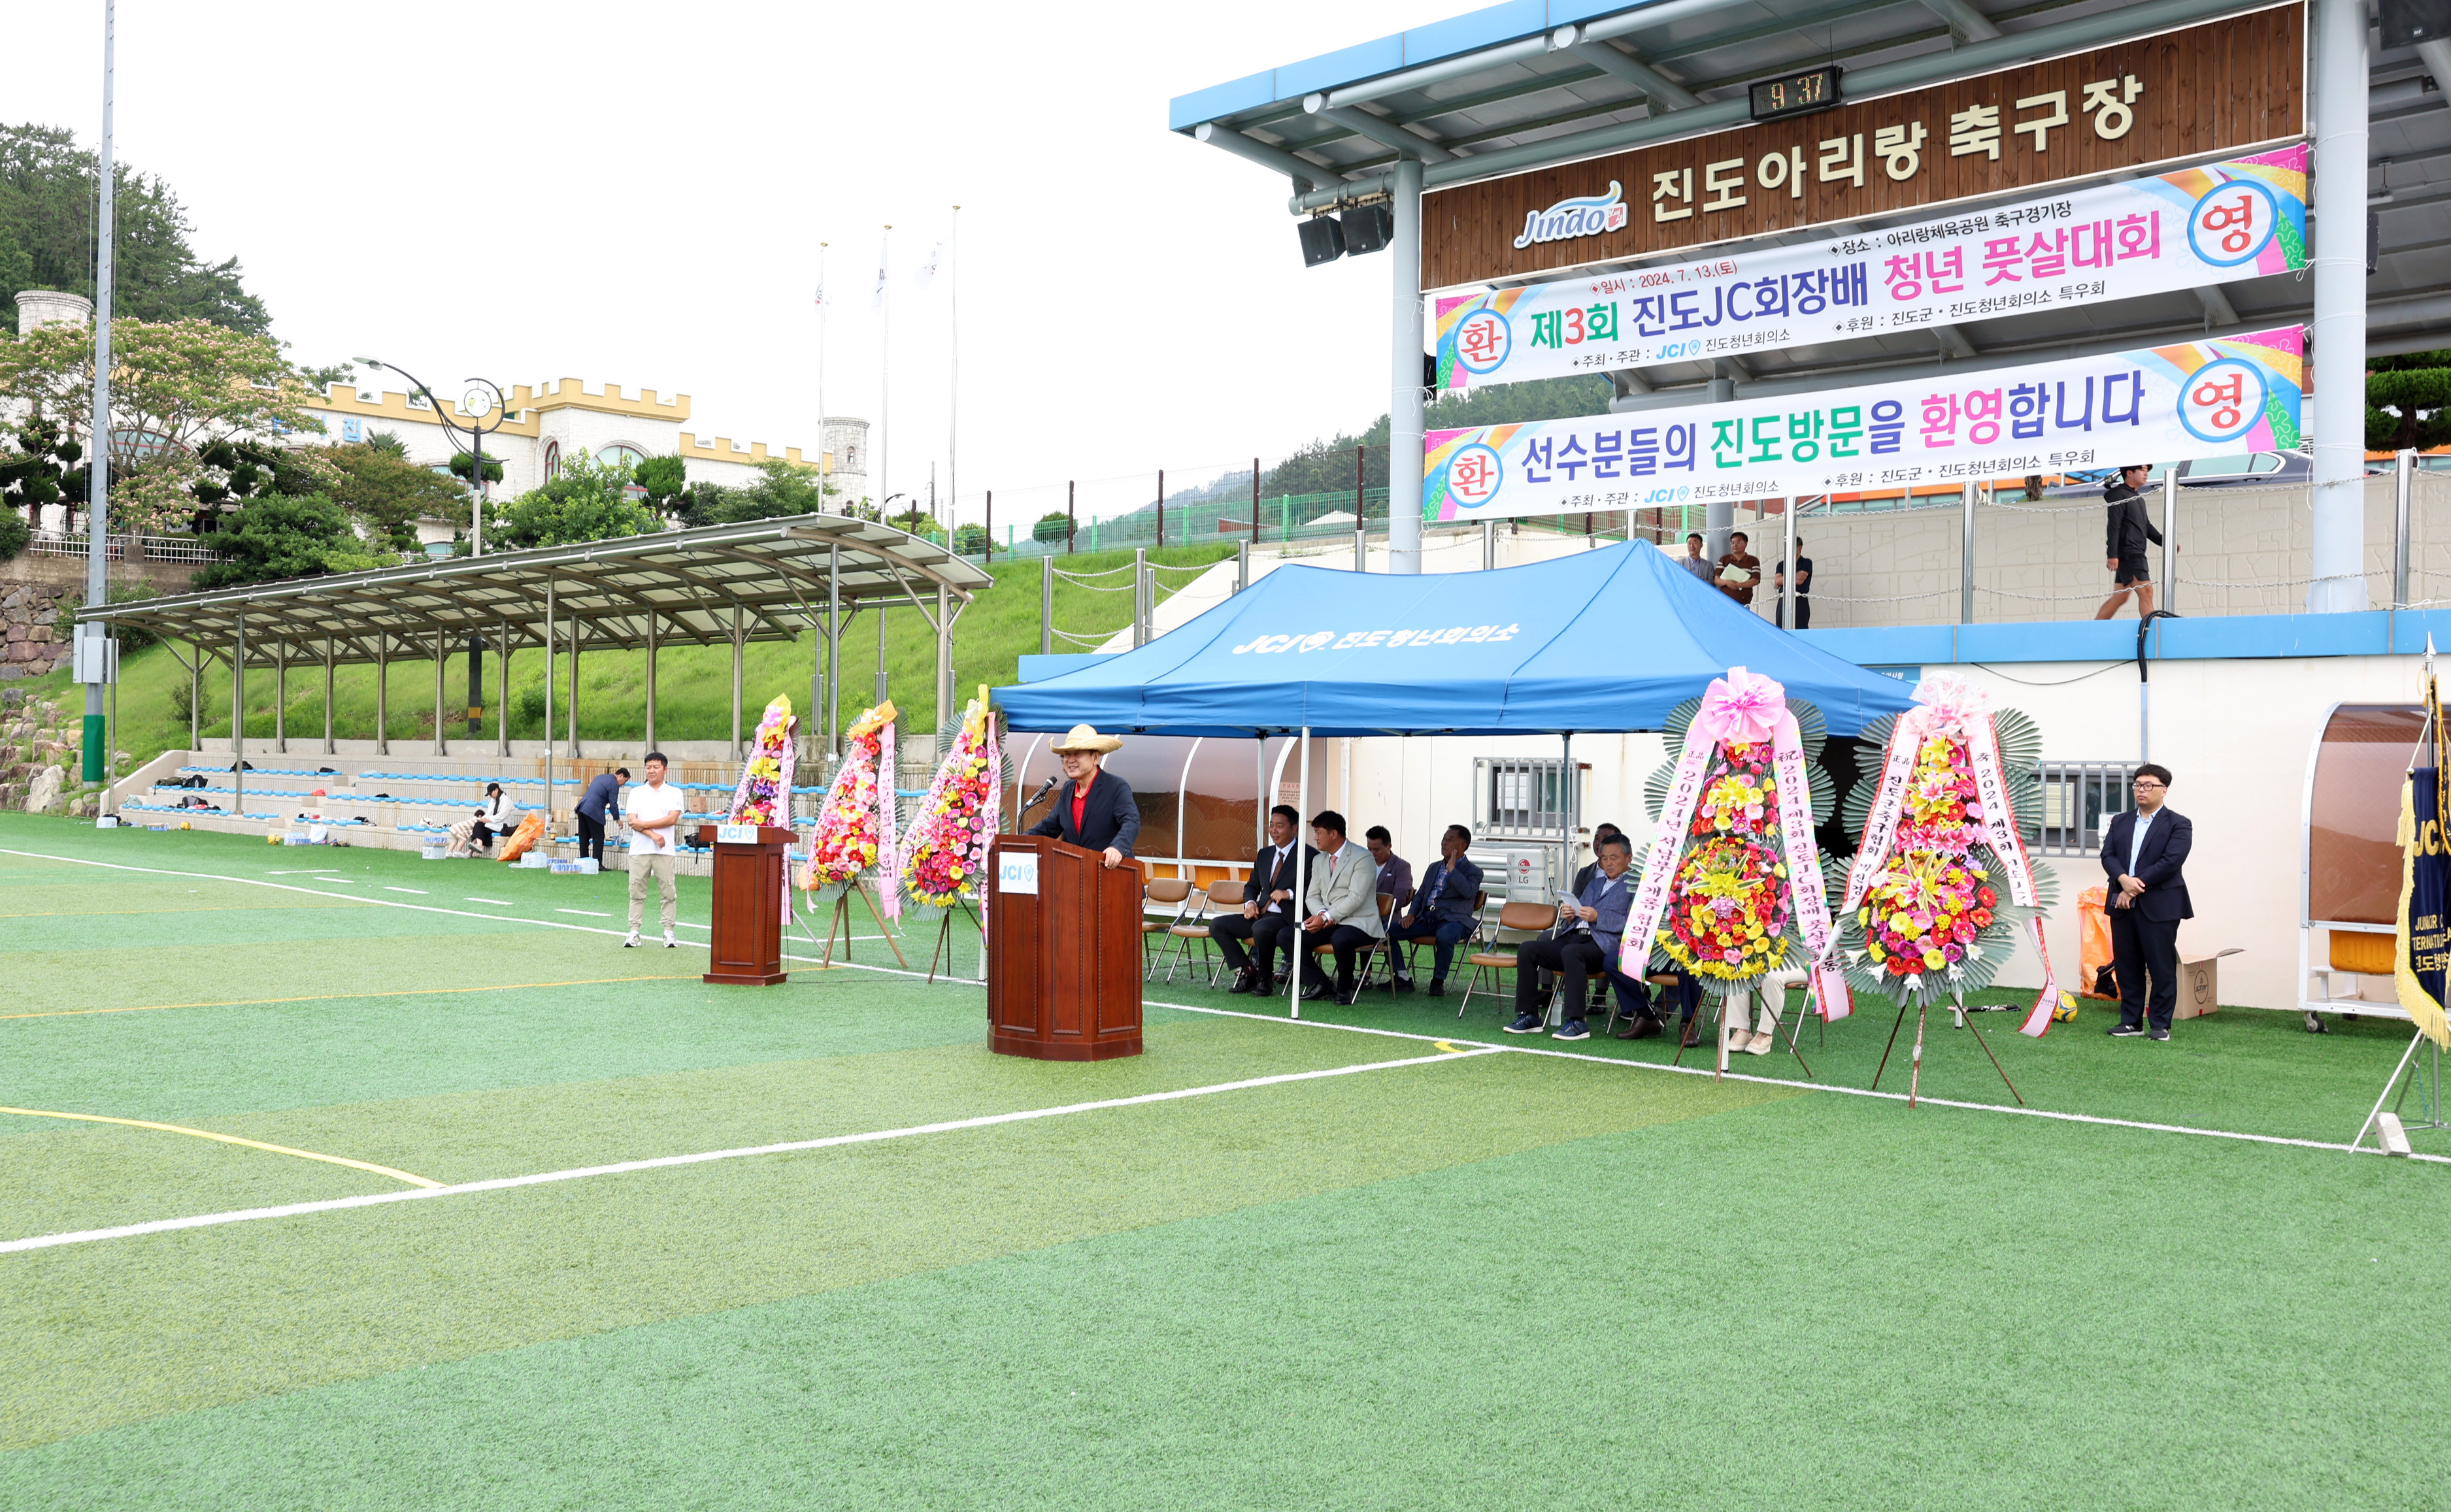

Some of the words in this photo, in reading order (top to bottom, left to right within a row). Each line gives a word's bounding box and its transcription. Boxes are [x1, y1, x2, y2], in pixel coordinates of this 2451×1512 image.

[1652, 121, 1927, 223] 진도아리랑
[1949, 74, 2144, 161] 축구장
[1517, 208, 1605, 244] Jindo
[1842, 237, 1871, 254] 장소
[1887, 217, 1990, 246] 아리랑체육공원
[1995, 201, 2072, 229] 축구경기장
[2201, 195, 2254, 254] 영
[1530, 301, 1619, 349] 제3회
[1632, 261, 1869, 337] 진도JC회장배
[1883, 246, 1964, 301] 청년
[1983, 210, 2160, 286] 풋살대회
[1601, 278, 1626, 294] 일시
[1639, 272, 1675, 288] 2024.
[1846, 316, 1873, 333] 후원
[1892, 308, 1933, 327] 진도군
[1950, 289, 2052, 318] 진도청년회의소
[2058, 280, 2105, 301] 특우회
[1460, 320, 1503, 363] 환
[1582, 353, 1605, 368] 주최
[1616, 349, 1641, 364] 주관
[1656, 342, 1686, 359] JCI
[1706, 328, 1791, 352] 진도청년회의소
[2192, 374, 2243, 430] 영
[1522, 423, 1695, 484] 선수분들의
[1710, 399, 1905, 469] 진도방문을
[1919, 369, 2145, 449] 환영합니다
[1450, 453, 1494, 496] 환
[1835, 472, 1863, 487] 후원
[1880, 467, 1922, 484] 진도군
[1939, 455, 2041, 479] 진도청년회의소
[2048, 448, 2095, 467] 특우회
[1570, 493, 1593, 508] 주최
[1605, 491, 1629, 505] 주관
[1644, 488, 1675, 503] JCI
[1694, 480, 1779, 499] 진도청년회의소
[1232, 634, 1307, 655] JCI
[1331, 623, 1520, 649] 진도청년회의소
[1668, 770, 1696, 831] 2024년
[1783, 765, 1800, 805] 2024
[1980, 768, 1999, 810] 2024
[718, 827, 742, 839] JCI
[1785, 809, 1805, 840] 제3회
[1989, 818, 2013, 852] 제3회
[2414, 819, 2444, 857] JC
[999, 865, 1022, 880] JCI
[1792, 842, 1822, 915] 진도JC회장배
[2415, 914, 2438, 931] JUNIOR
